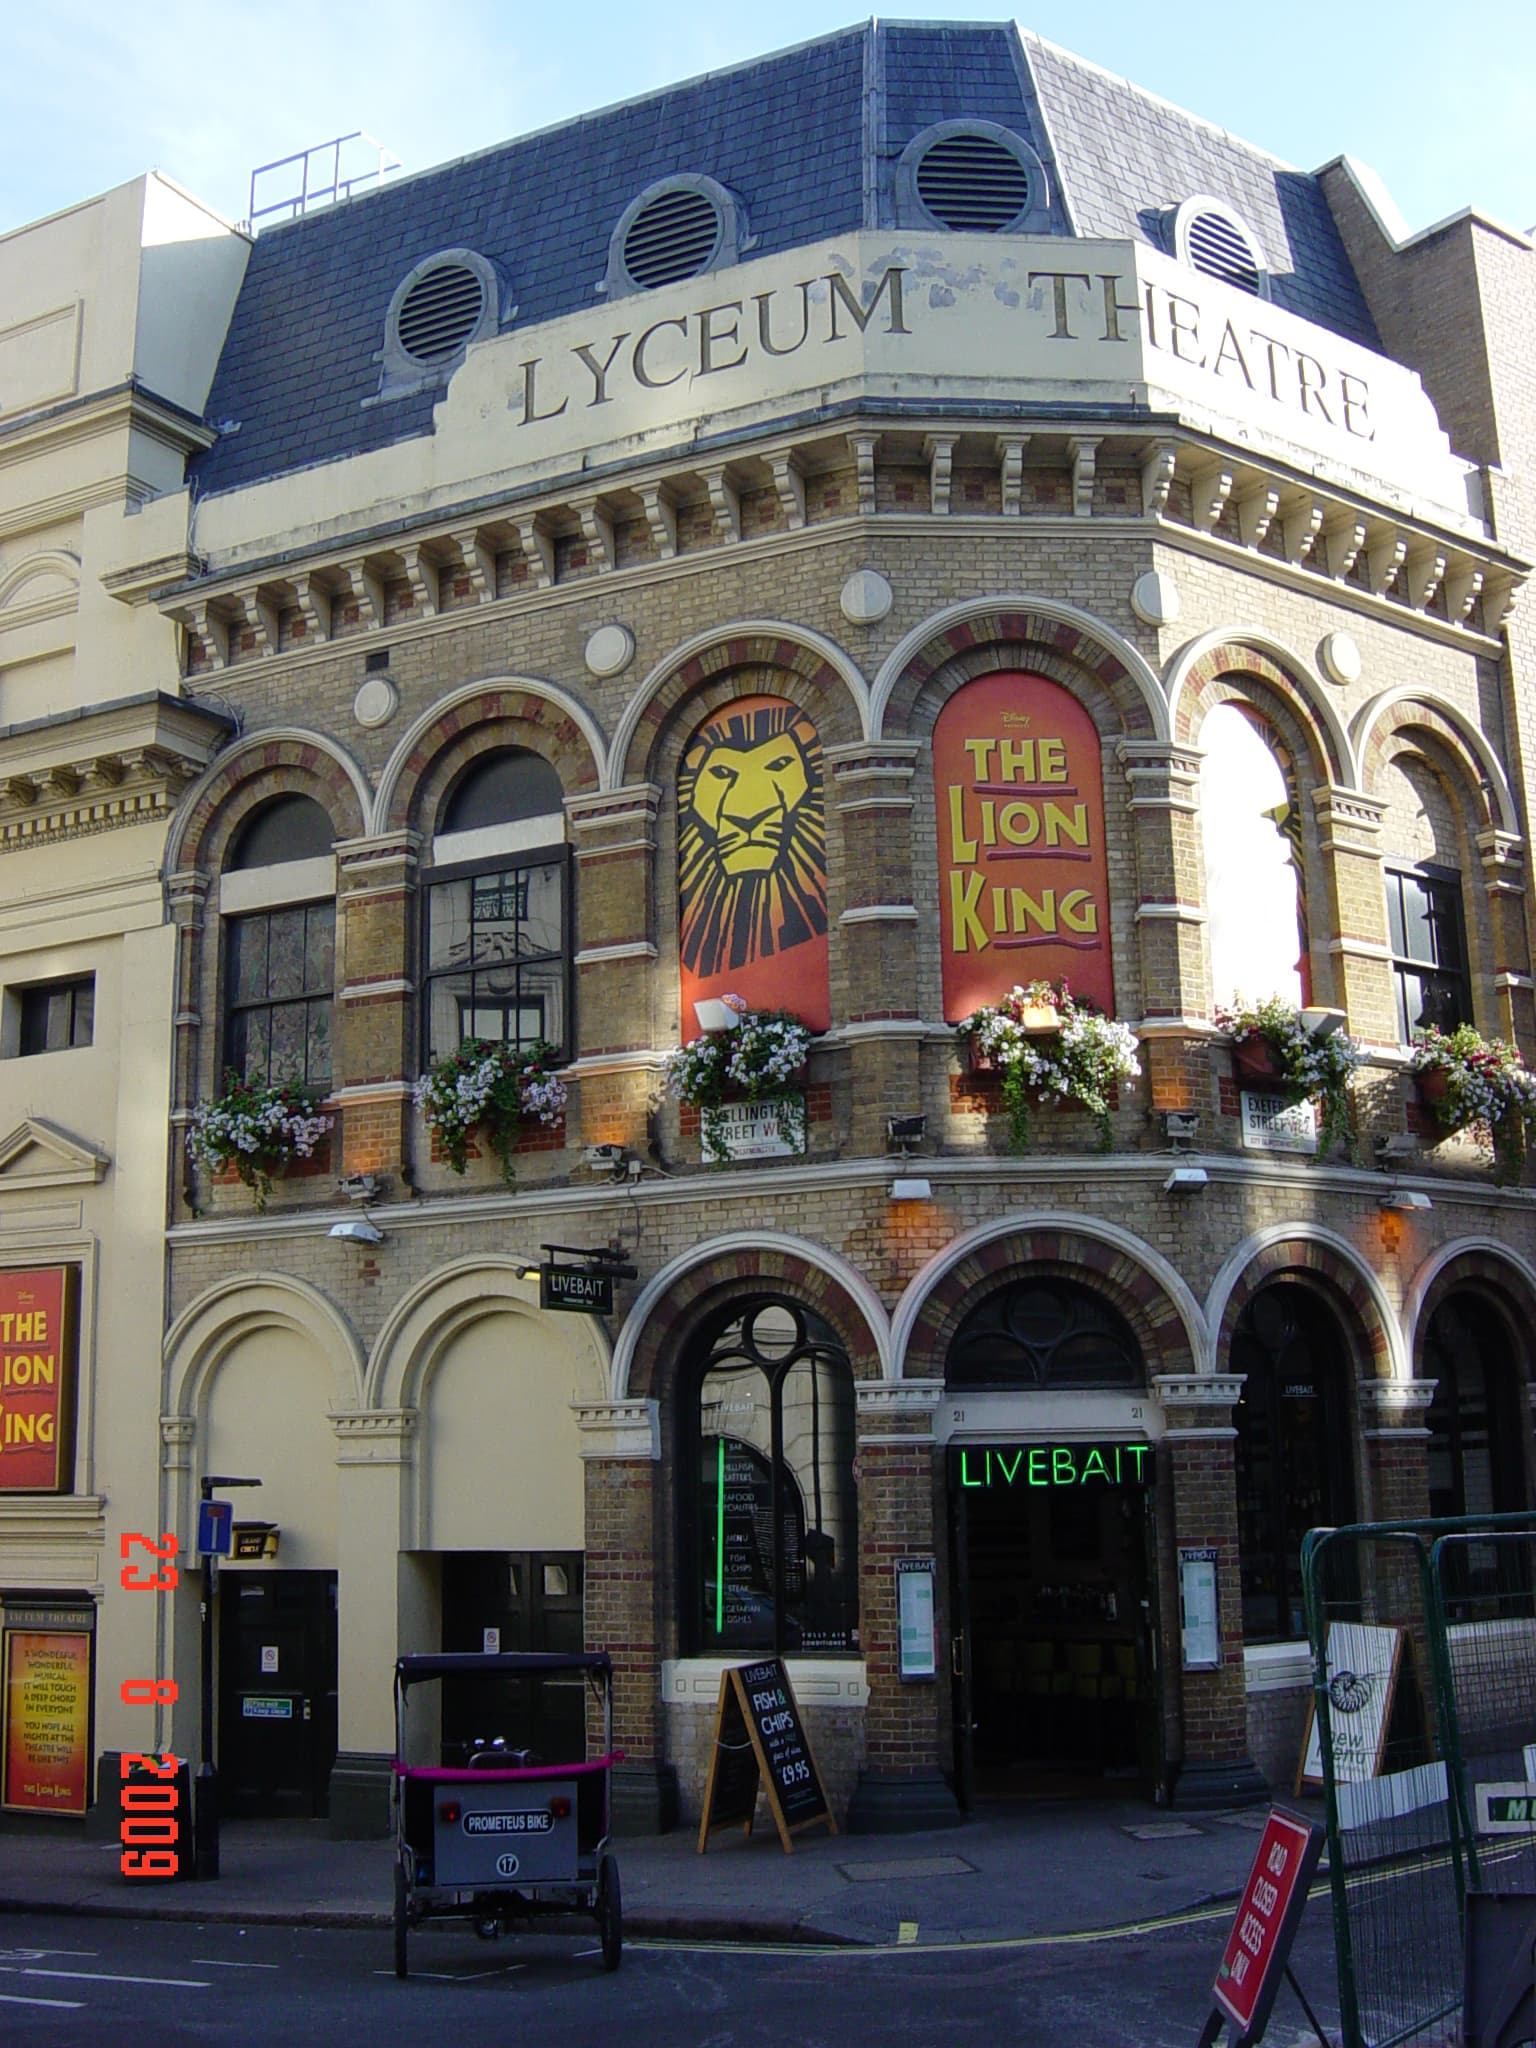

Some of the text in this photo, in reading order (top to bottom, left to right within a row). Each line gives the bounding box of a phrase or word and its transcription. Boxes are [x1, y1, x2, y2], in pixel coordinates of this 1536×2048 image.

[517, 266, 1376, 442] LYCEUM THEATRE
[1000, 711, 1030, 724] Disney
[965, 738, 1069, 783] THE
[949, 785, 1090, 863] LION
[950, 870, 1098, 952] KING
[1249, 1114, 1286, 1132] STREET
[551, 1274, 604, 1297] LIVEBAIT
[0, 1311, 47, 1343] THE
[0, 1354, 55, 1393] ION
[953, 1409, 965, 1422] 21
[1131, 1406, 1143, 1419] 21
[0, 1403, 55, 1451] ING
[960, 1445, 1151, 1488] LIVEBAIT
[744, 1663, 779, 1683] LIVEBAIT
[24, 1681, 77, 1692] IT WILL TOUCH
[31, 1693, 48, 1702] DEEP
[49, 1694, 76, 1703] CHORD
[26, 1703, 73, 1714] IN EVERYONE
[753, 1688, 786, 1713] FISH &
[24, 1721, 40, 1730] YOU
[61, 1724, 74, 1732] ALL
[761, 1710, 794, 1735] CHIPS
[23, 1732, 49, 1742] NIGHTS
[782, 1759, 810, 1785] £9.95
[36, 1782, 54, 1796] LION
[54, 1784, 73, 1798] KING
[468, 1814, 549, 1831] PROMETEUS BIKE
[501, 1857, 514, 1872] 17
[1267, 1841, 1288, 1877] ROAD
[1251, 1875, 1279, 1918] CLOSED
[1238, 1910, 1266, 1957] ACCESS
